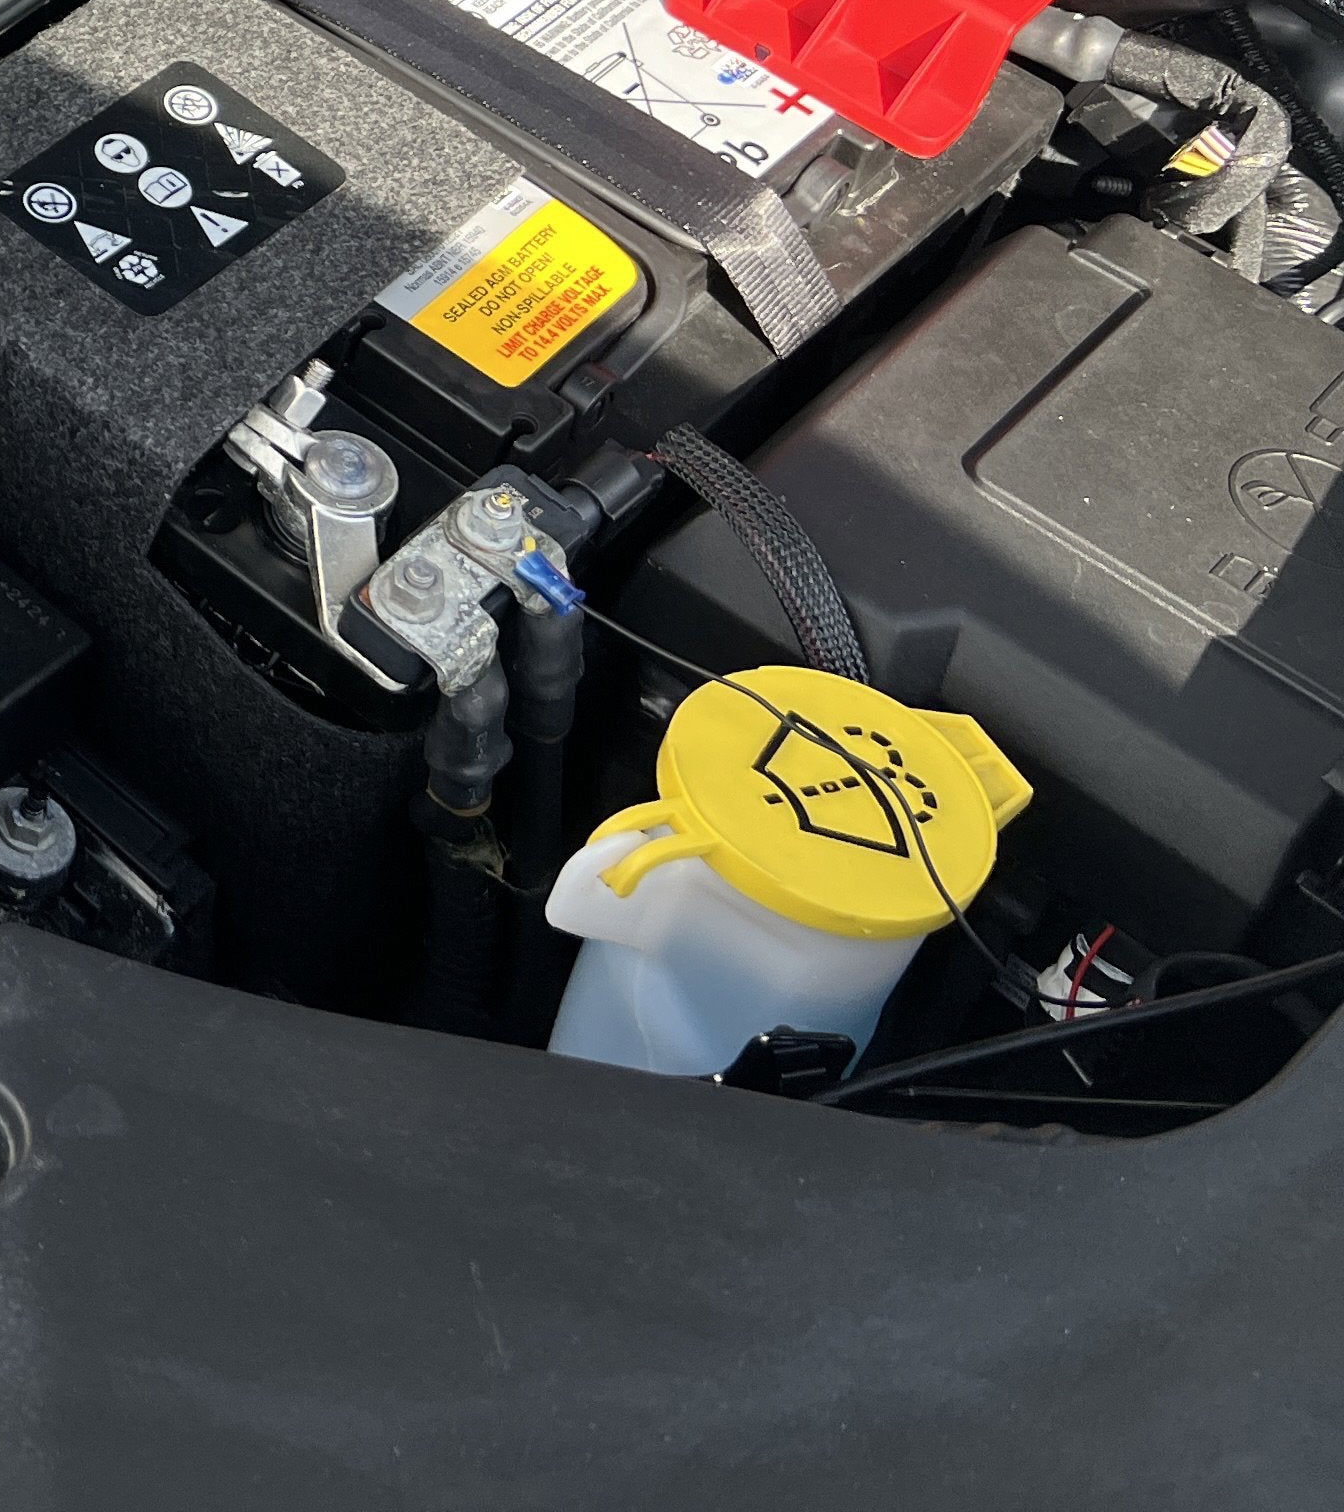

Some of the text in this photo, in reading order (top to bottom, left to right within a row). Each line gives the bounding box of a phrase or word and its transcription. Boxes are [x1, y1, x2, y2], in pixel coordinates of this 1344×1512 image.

[714, 140, 769, 167] b
[443, 225, 557, 322] SEALED AGM BATTERY
[478, 253, 554, 316] DO NOT OPEN!
[492, 264, 576, 332] NON-SPILLABLE
[496, 265, 603, 357] LIMIT CHARGE VOLTAGE
[518, 281, 612, 362] TO 14.4 VOLTS MAX.
